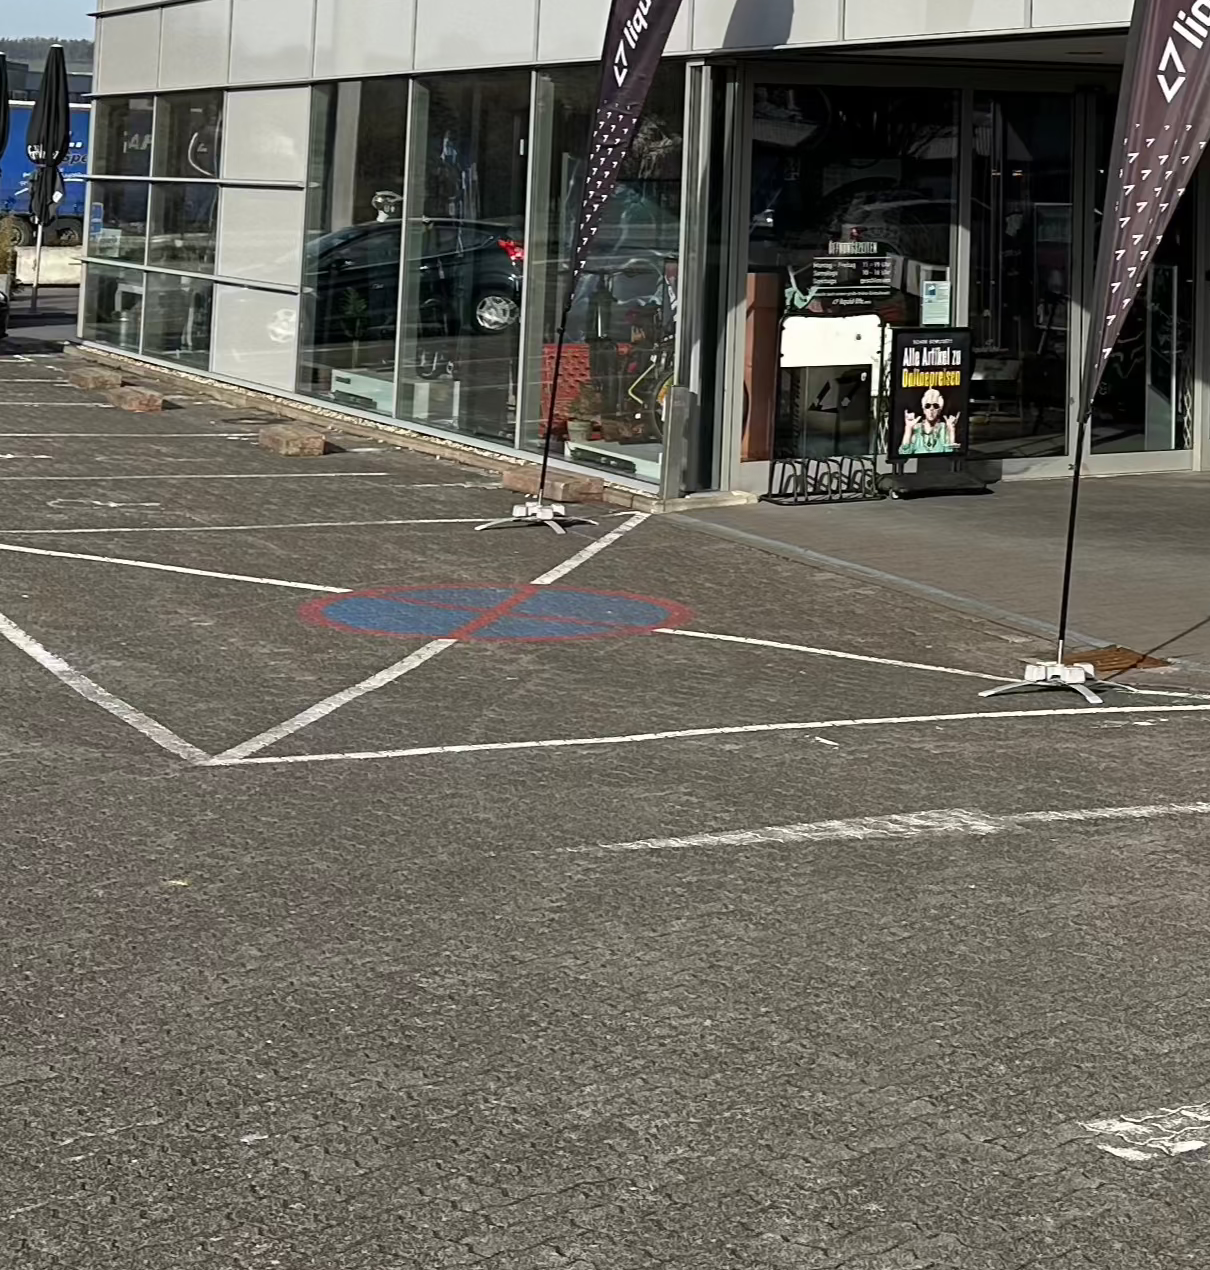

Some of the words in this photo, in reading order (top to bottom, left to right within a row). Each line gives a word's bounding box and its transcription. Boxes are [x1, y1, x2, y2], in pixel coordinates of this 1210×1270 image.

[902, 347, 920, 367] Alle
[921, 346, 951, 366] Artikel
[951, 349, 962, 366] zu
[902, 367, 961, 389] Onlinepreisen
